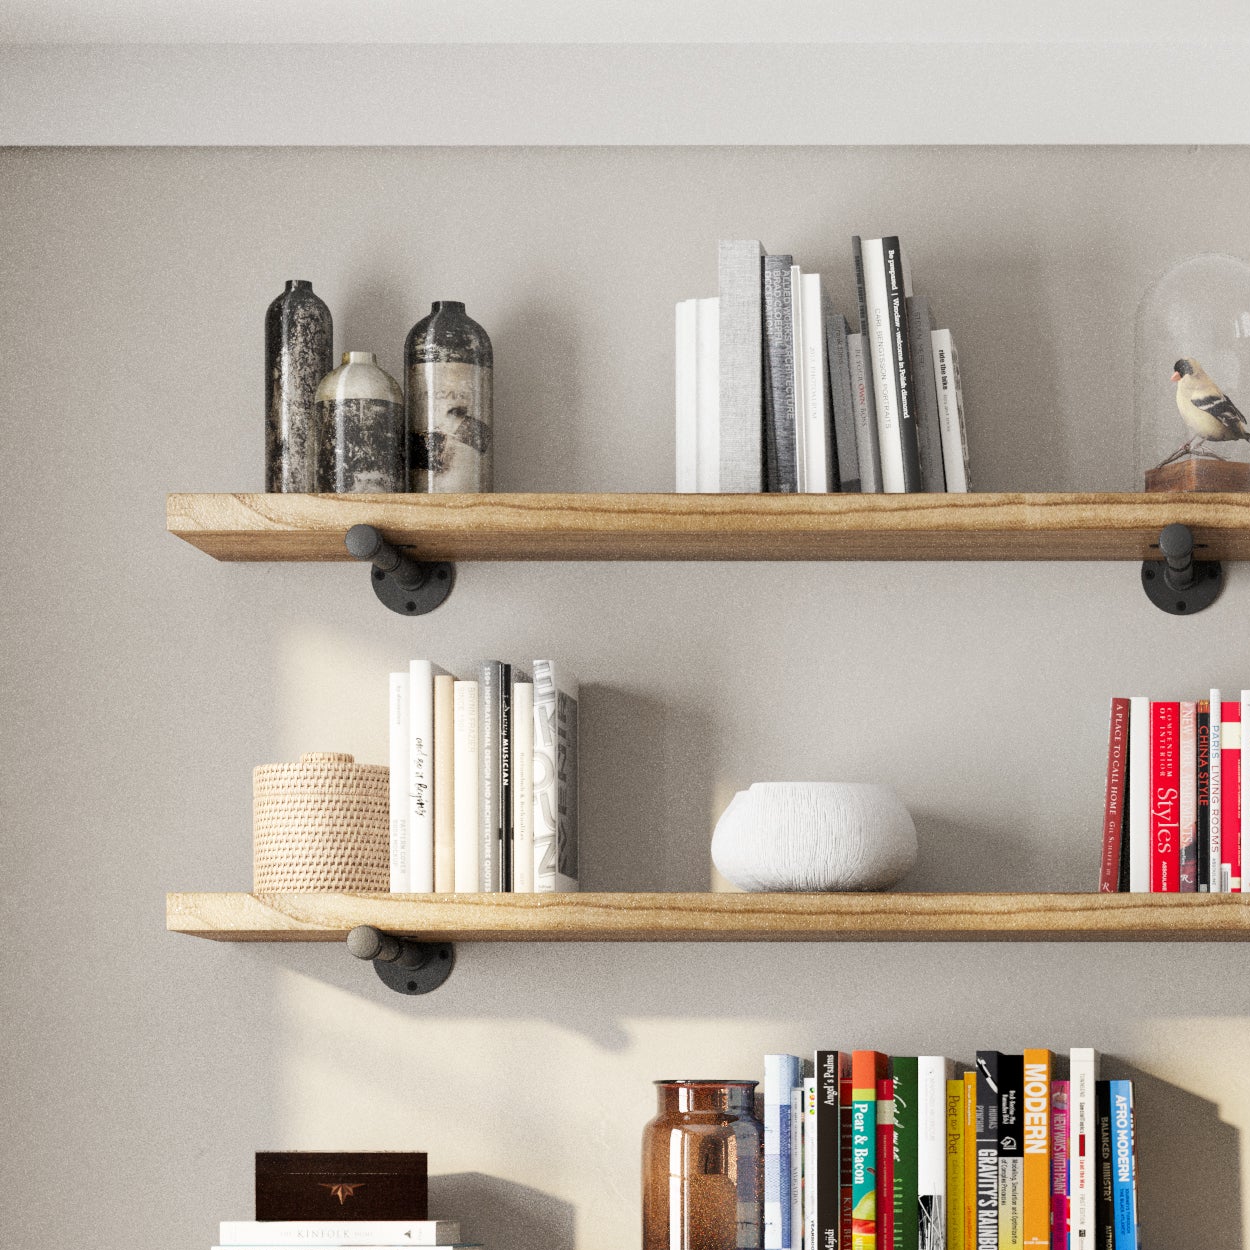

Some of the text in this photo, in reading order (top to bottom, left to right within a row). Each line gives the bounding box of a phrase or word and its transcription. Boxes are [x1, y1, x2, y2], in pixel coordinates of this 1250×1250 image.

[888, 250, 895, 259] Be
[773, 270, 782, 298] BRAD
[888, 260, 898, 290] prepared
[764, 270, 774, 334] OCCUPATION
[895, 332, 904, 362] welcome
[784, 307, 794, 419] WORKS ARCHITECTURE
[899, 369, 907, 388] Polish
[858, 383, 866, 405] OWN
[882, 384, 891, 428] PORTRAITS
[902, 389, 910, 419] diamond
[1114, 713, 1123, 741] PLACE
[1160, 708, 1167, 721] OF
[1182, 710, 1194, 736] NEW
[1112, 744, 1121, 758] TO
[1182, 740, 1194, 771] YORK
[1112, 760, 1120, 784] CALL
[1200, 725, 1209, 806] CHINA STYLE
[484, 687, 492, 892] INSPIRATIONAL DESIGN AND ARCHITECTURE QUOTES
[1109, 786, 1118, 815] HOME
[1212, 726, 1220, 852] PARIS LIVING ROOMS
[1152, 788, 1179, 854] Styles
[1182, 774, 1194, 844] APARTMENTS
[824, 1054, 835, 1078] Psalms
[948, 1095, 961, 1117] Poet
[988, 1105, 998, 1130] THOMAS
[1024, 1064, 1048, 1154] MODERN
[1054, 1114, 1066, 1132] NEW
[854, 1102, 869, 1184] Pear & Bacon
[948, 1134, 961, 1155] Poet
[1054, 1132, 1066, 1152] WAYS
[1116, 1094, 1131, 1182] AFRO MODERN
[1054, 1152, 1066, 1172] WITH
[1100, 1116, 1112, 1202] BALANCED MINISTRY
[977, 1149, 998, 1208] GRAVITY'S
[1054, 1173, 1066, 1196] PAINT
[844, 1197, 852, 1225] KATE
[297, 1229, 350, 1238] KINFOLK
[1010, 1216, 1018, 1244] Optimization
